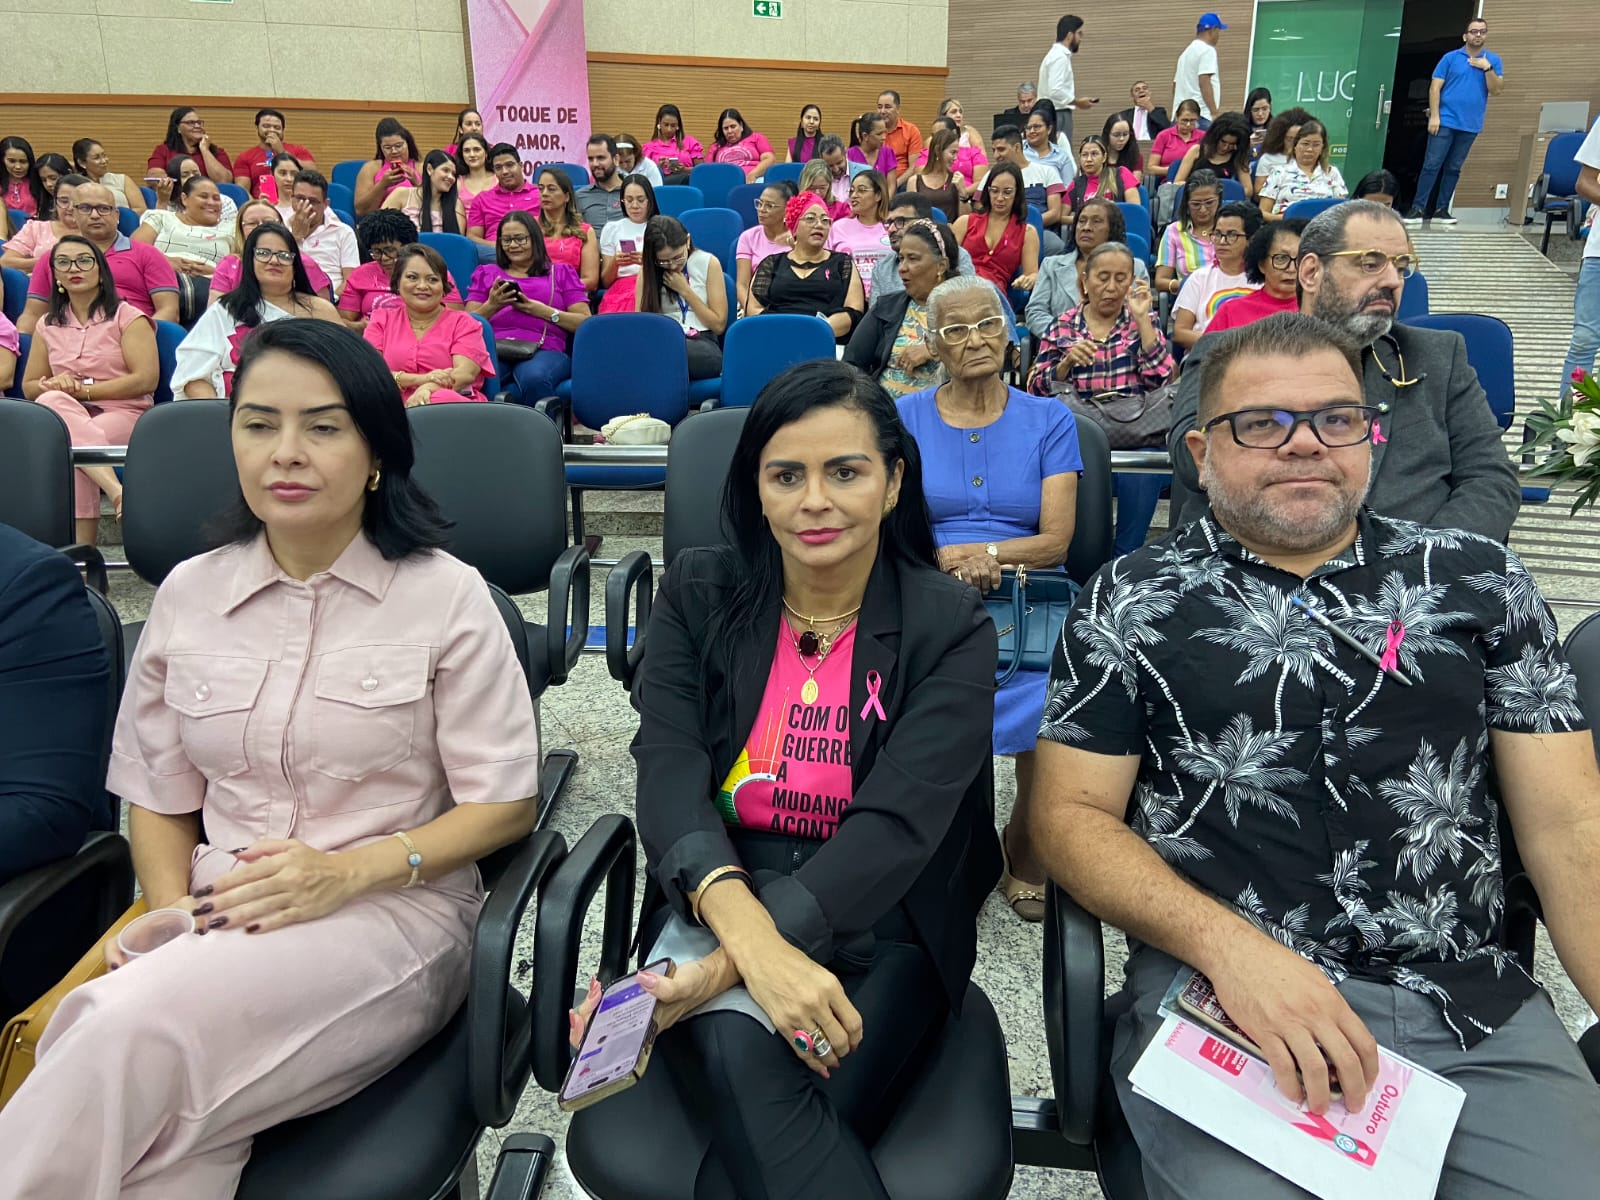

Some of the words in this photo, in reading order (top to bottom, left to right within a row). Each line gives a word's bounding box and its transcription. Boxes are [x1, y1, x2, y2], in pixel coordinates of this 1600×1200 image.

[495, 105, 551, 123] TOQUE
[557, 107, 578, 124] DE
[515, 133, 565, 152] AMOR,
[788, 703, 831, 731] COM
[835, 705, 849, 732] O
[776, 761, 788, 783] A
[1366, 1084, 1399, 1135] Outubro
